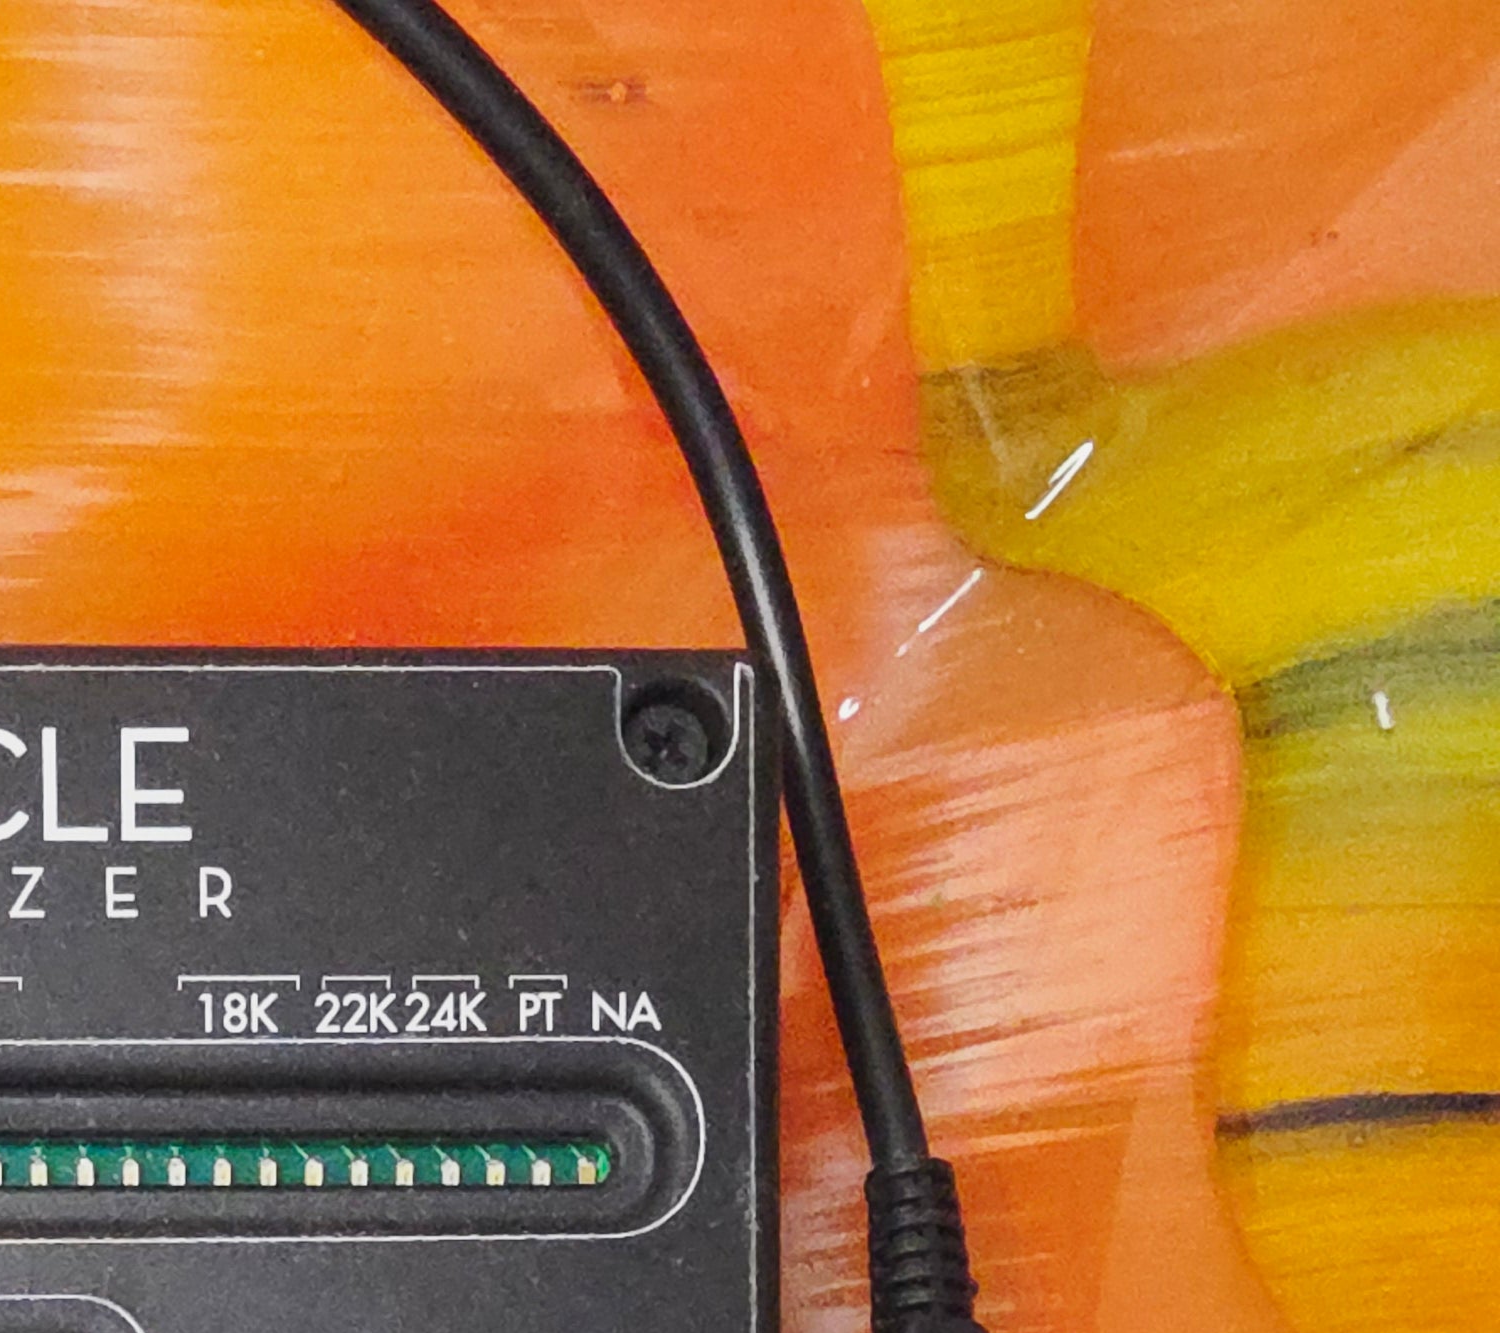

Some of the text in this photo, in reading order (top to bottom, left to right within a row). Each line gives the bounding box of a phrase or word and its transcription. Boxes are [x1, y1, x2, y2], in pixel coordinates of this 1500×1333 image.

[198, 991, 279, 1034] 18K
[314, 991, 398, 1034] 22K
[403, 990, 487, 1033] 24K
[518, 990, 562, 1032] PT
[591, 990, 663, 1032] NA
